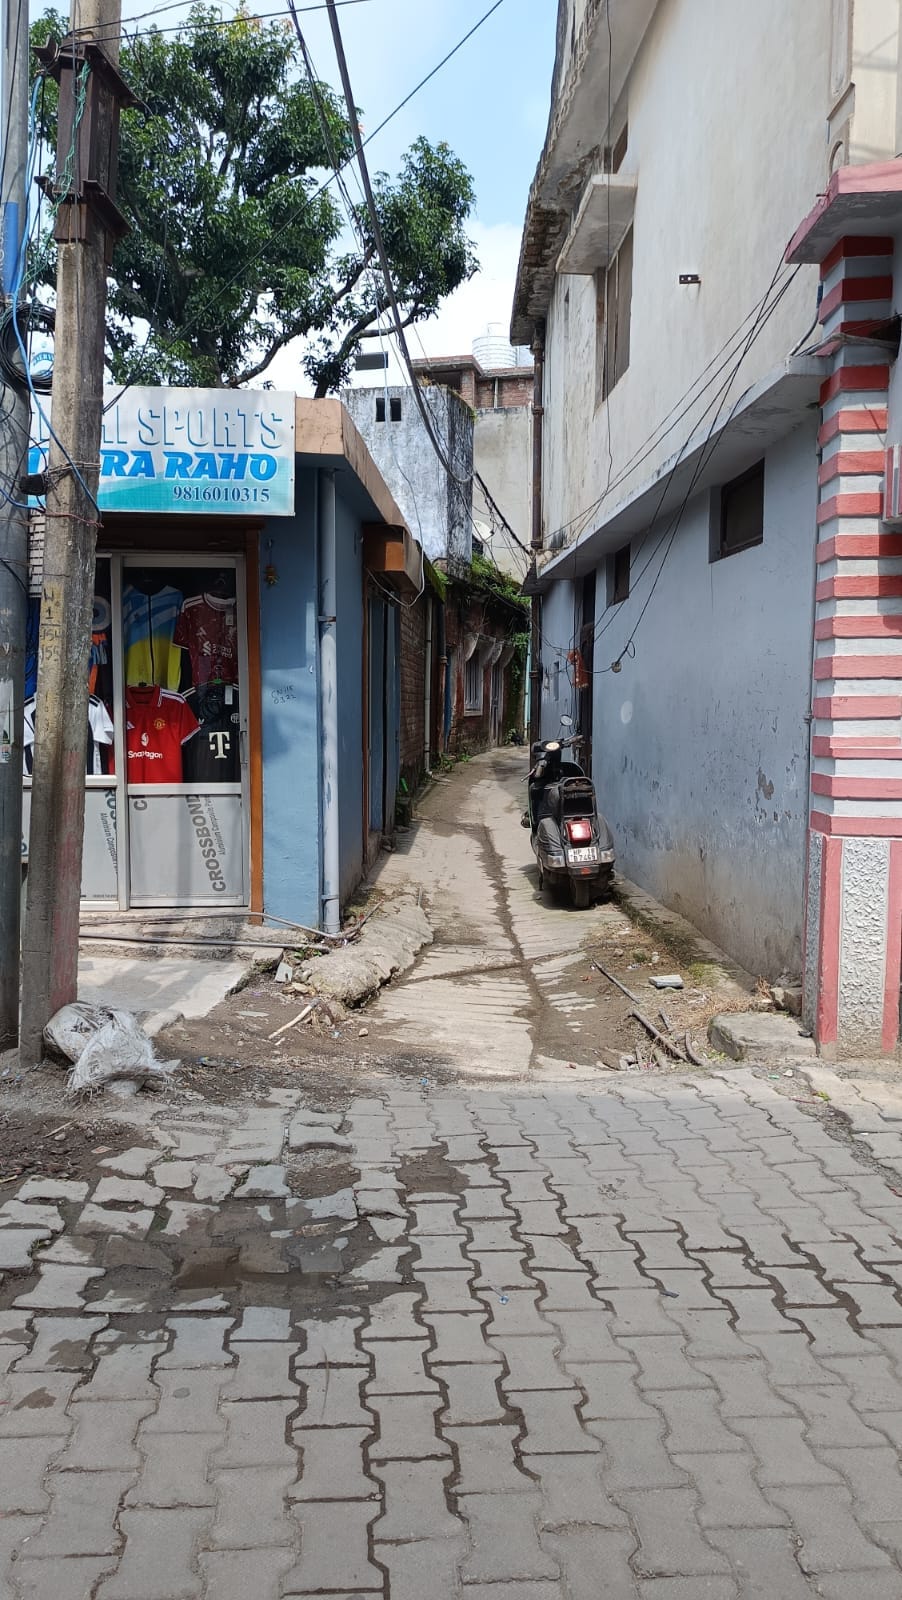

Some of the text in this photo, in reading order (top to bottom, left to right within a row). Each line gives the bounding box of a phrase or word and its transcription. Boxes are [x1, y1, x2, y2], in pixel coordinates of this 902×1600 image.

[138, 405, 284, 449] SPORTS
[163, 451, 277, 481] RAHO
[173, 486, 270, 502] 9816010315
